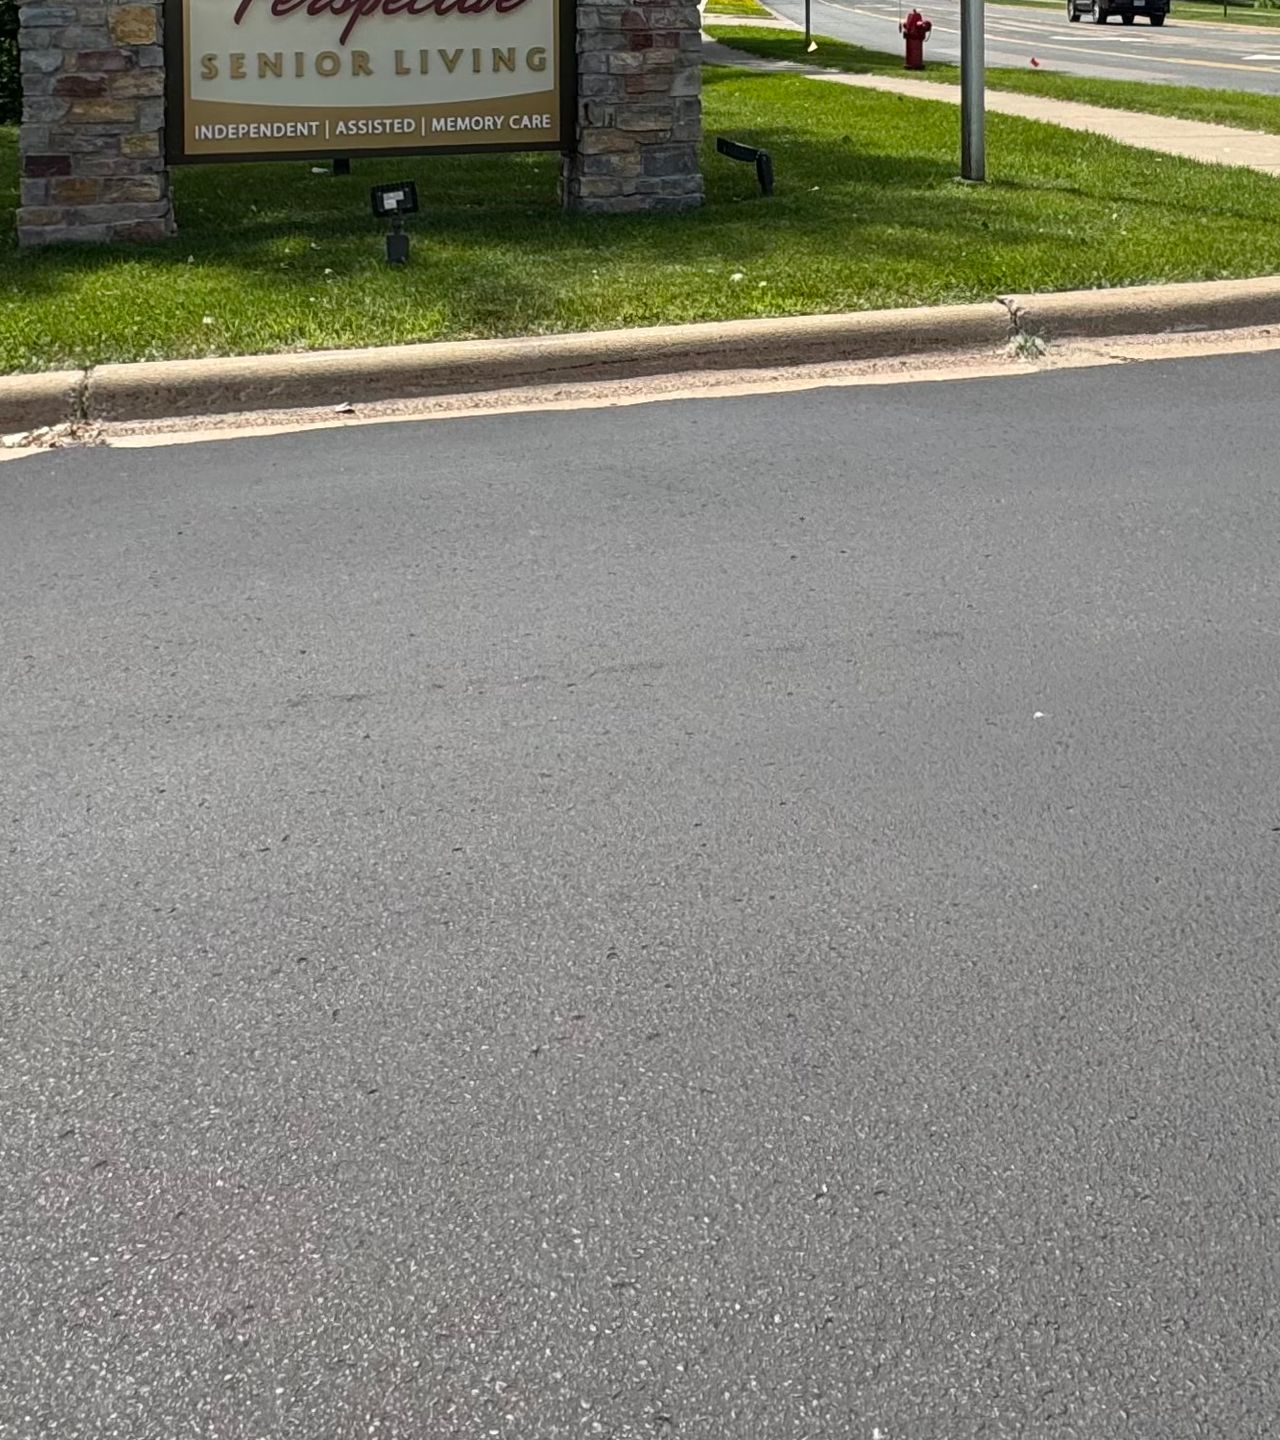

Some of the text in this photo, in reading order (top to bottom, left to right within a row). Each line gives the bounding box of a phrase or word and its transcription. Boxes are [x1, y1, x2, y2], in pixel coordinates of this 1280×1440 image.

[200, 46, 547, 80] SENIOR LIVING
[195, 114, 551, 140] INDEPENDENT ASSISTED MEMORY CARE
